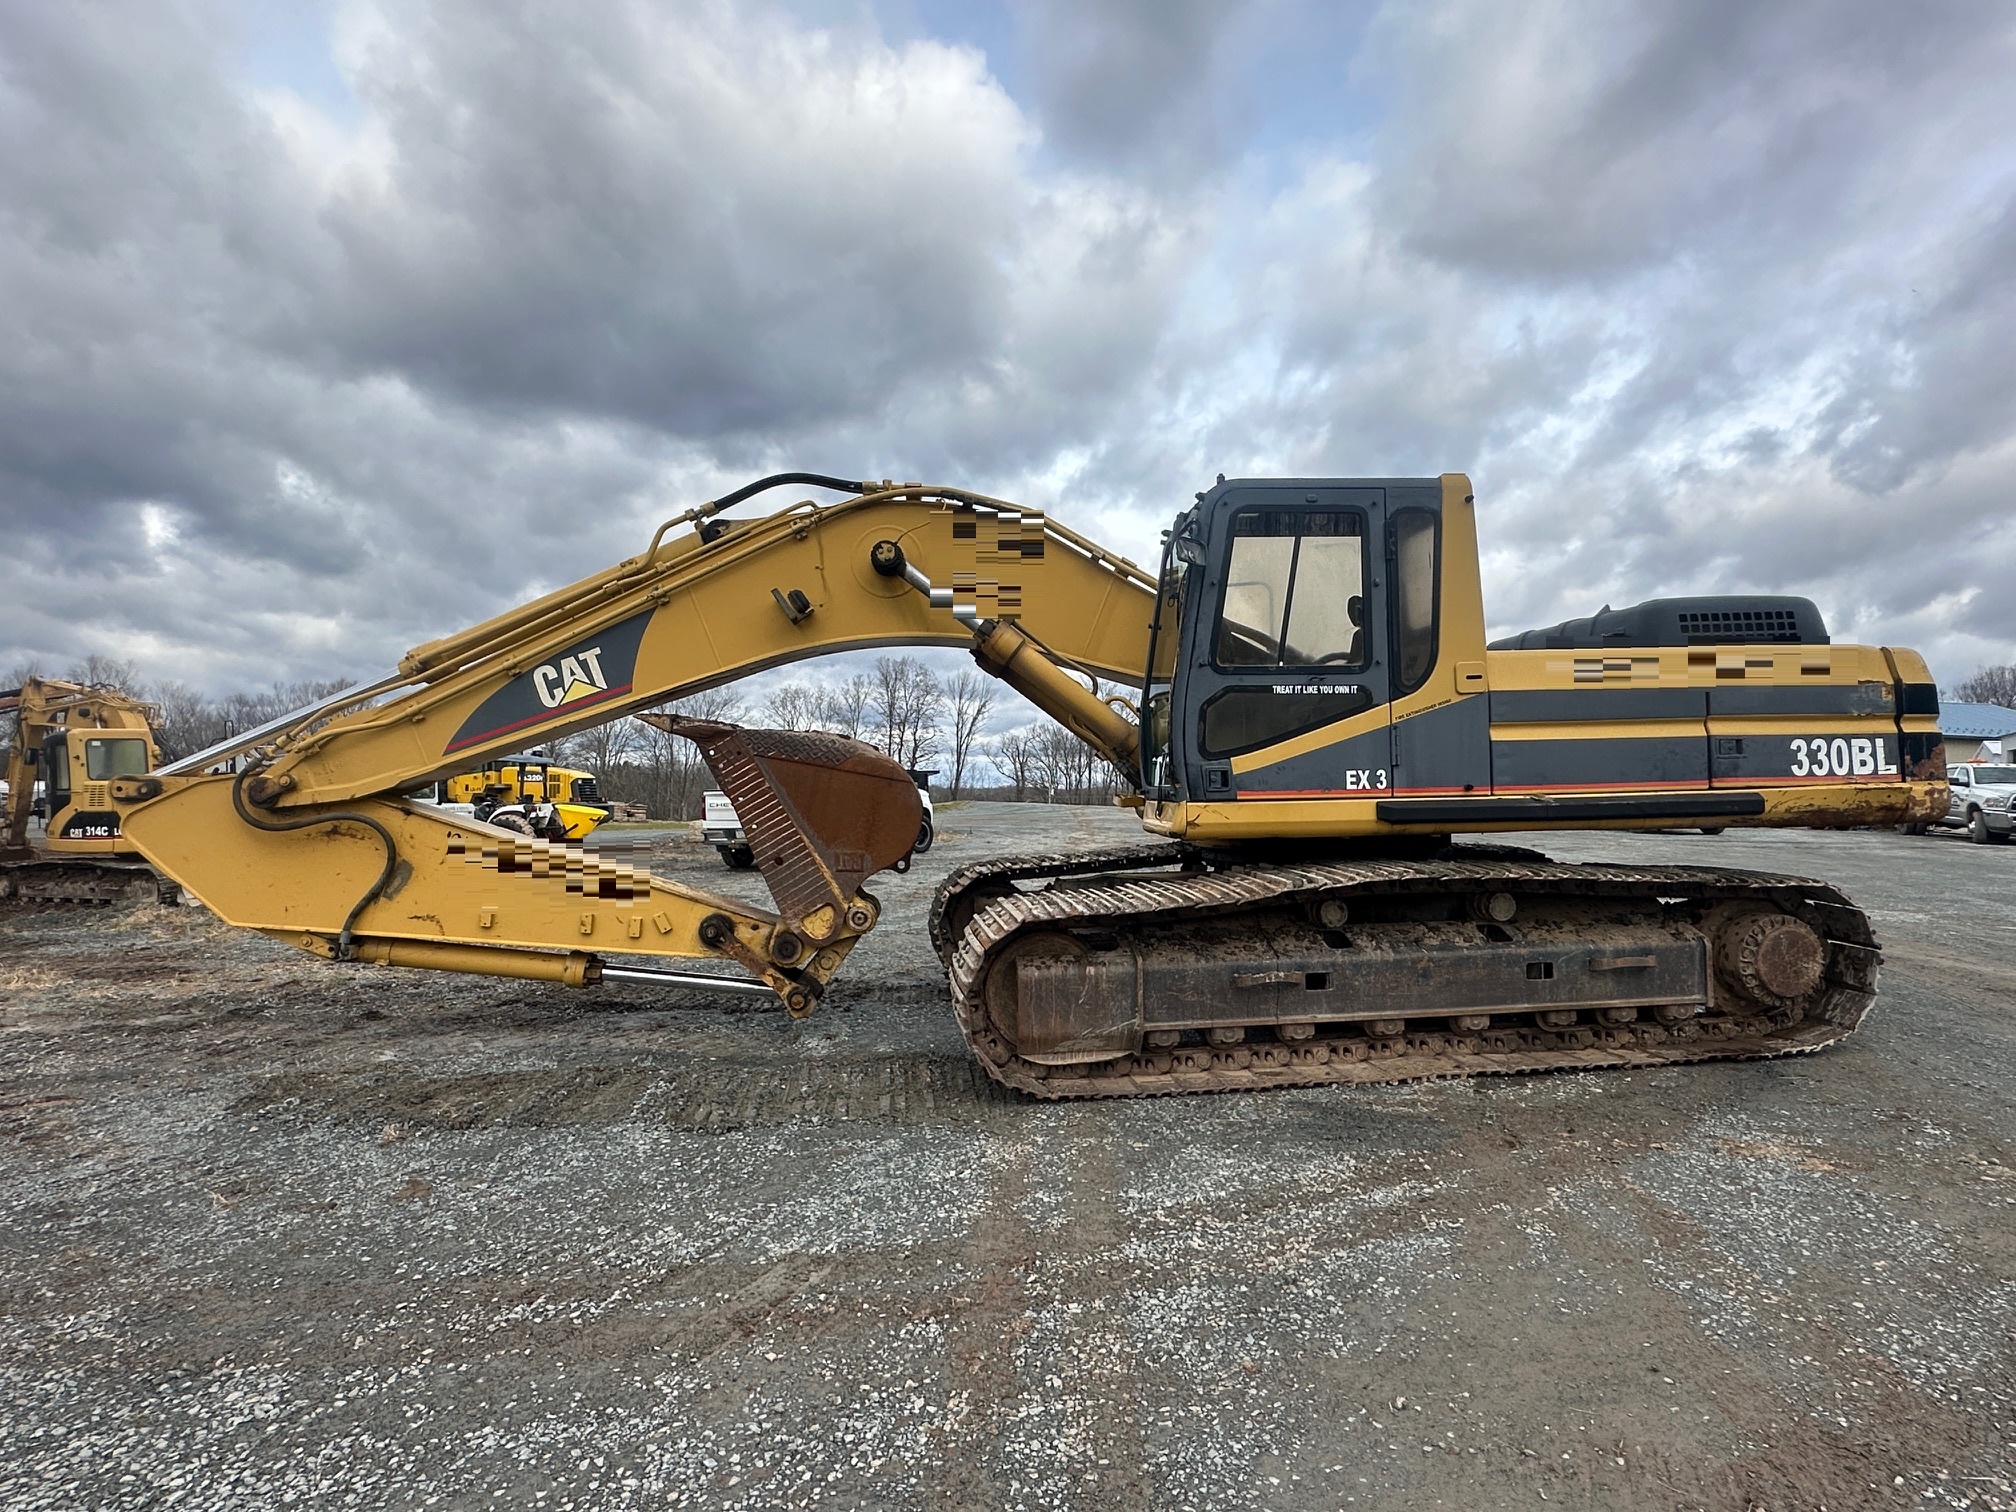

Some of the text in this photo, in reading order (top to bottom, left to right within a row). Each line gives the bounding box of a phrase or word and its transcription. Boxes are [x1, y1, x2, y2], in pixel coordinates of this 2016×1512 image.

[533, 647, 608, 708] CAT
[1272, 685, 1358, 694] TREAT IT LIKE YOU OWN IT
[1790, 738, 1898, 776] 330BL
[1346, 769, 1387, 790] EX 3
[70, 828, 83, 838] CAT
[85, 826, 109, 836] 314C
